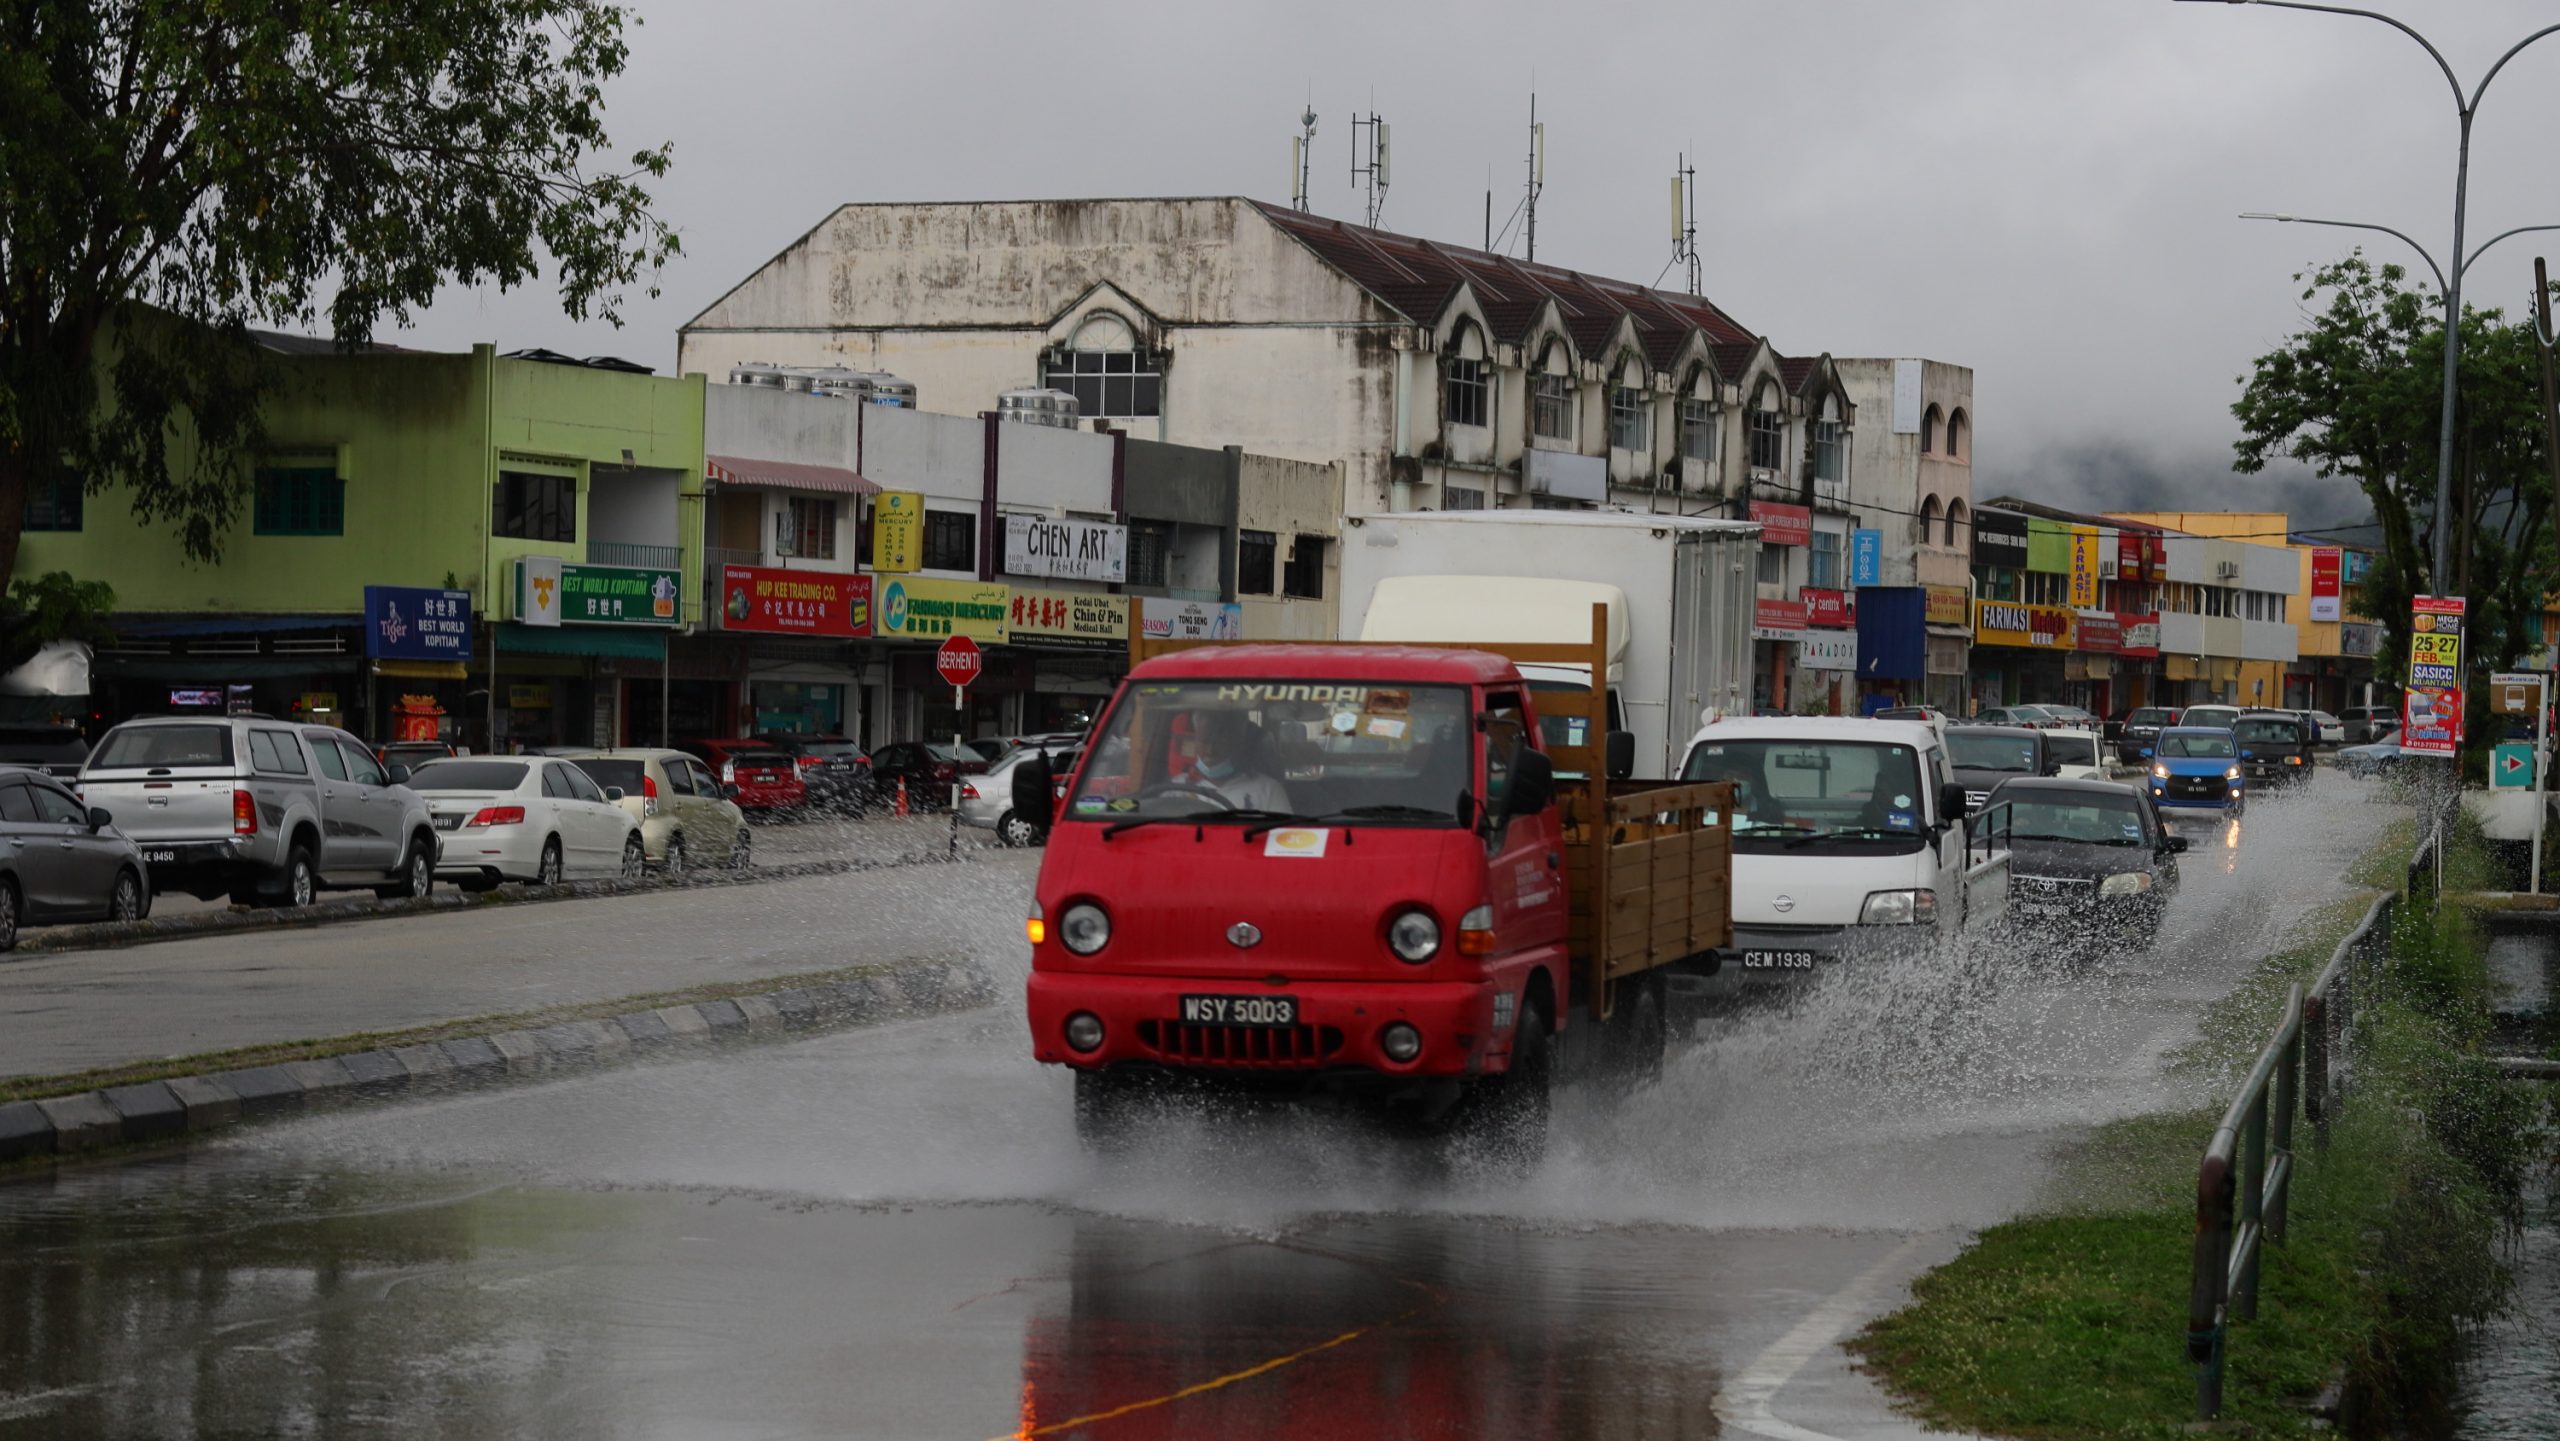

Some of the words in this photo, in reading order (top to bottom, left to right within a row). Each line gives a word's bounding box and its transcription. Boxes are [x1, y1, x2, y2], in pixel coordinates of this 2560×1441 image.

[1028, 523, 1071, 557] CHEN
[1079, 528, 1108, 560] ART
[2076, 535, 2085, 600] FARMASI
[562, 576, 582, 592] BEST
[583, 577, 609, 594] WORLD
[610, 578, 648, 596] KOPITIAM
[757, 581, 772, 597] HUP
[774, 582, 787, 598] KEE
[789, 583, 821, 600] TRADING
[823, 585, 837, 601] CO.
[907, 599, 954, 616] FARMASI
[956, 602, 1006, 620] MERCURY
[1074, 597, 1092, 607] Kedai
[1094, 598, 1109, 608] Ubat
[1818, 598, 1839, 611] centrix
[1074, 608, 1096, 622] Chin
[1098, 609, 1106, 622] &
[1108, 611, 1123, 624] Pin
[1179, 616, 1193, 624] TONG
[1194, 617, 1207, 626] SENG
[1983, 605, 2029, 631] FARMASI
[2437, 615, 2459, 623] MEGA
[380, 620, 407, 644] Tiger
[419, 620, 436, 632] BEST
[439, 621, 465, 633] WORLD
[1074, 623, 1098, 633] Medical
[1100, 624, 1112, 633] Hall
[1142, 619, 1168, 631] SEASONS
[425, 635, 459, 648] KOPITIAM
[2415, 636, 2433, 651] 25
[2439, 638, 2457, 653] 27
[940, 651, 979, 670] BERHENTI
[2414, 652, 2441, 663] FEB.
[2414, 666, 2452, 680] SASICC
[2413, 678, 2452, 687] KUANTAN
[1218, 685, 1367, 701] HYUNDAI
[1745, 953, 1773, 967] CEM
[1776, 952, 1812, 968] 1938
[1185, 998, 1227, 1021] WSY
